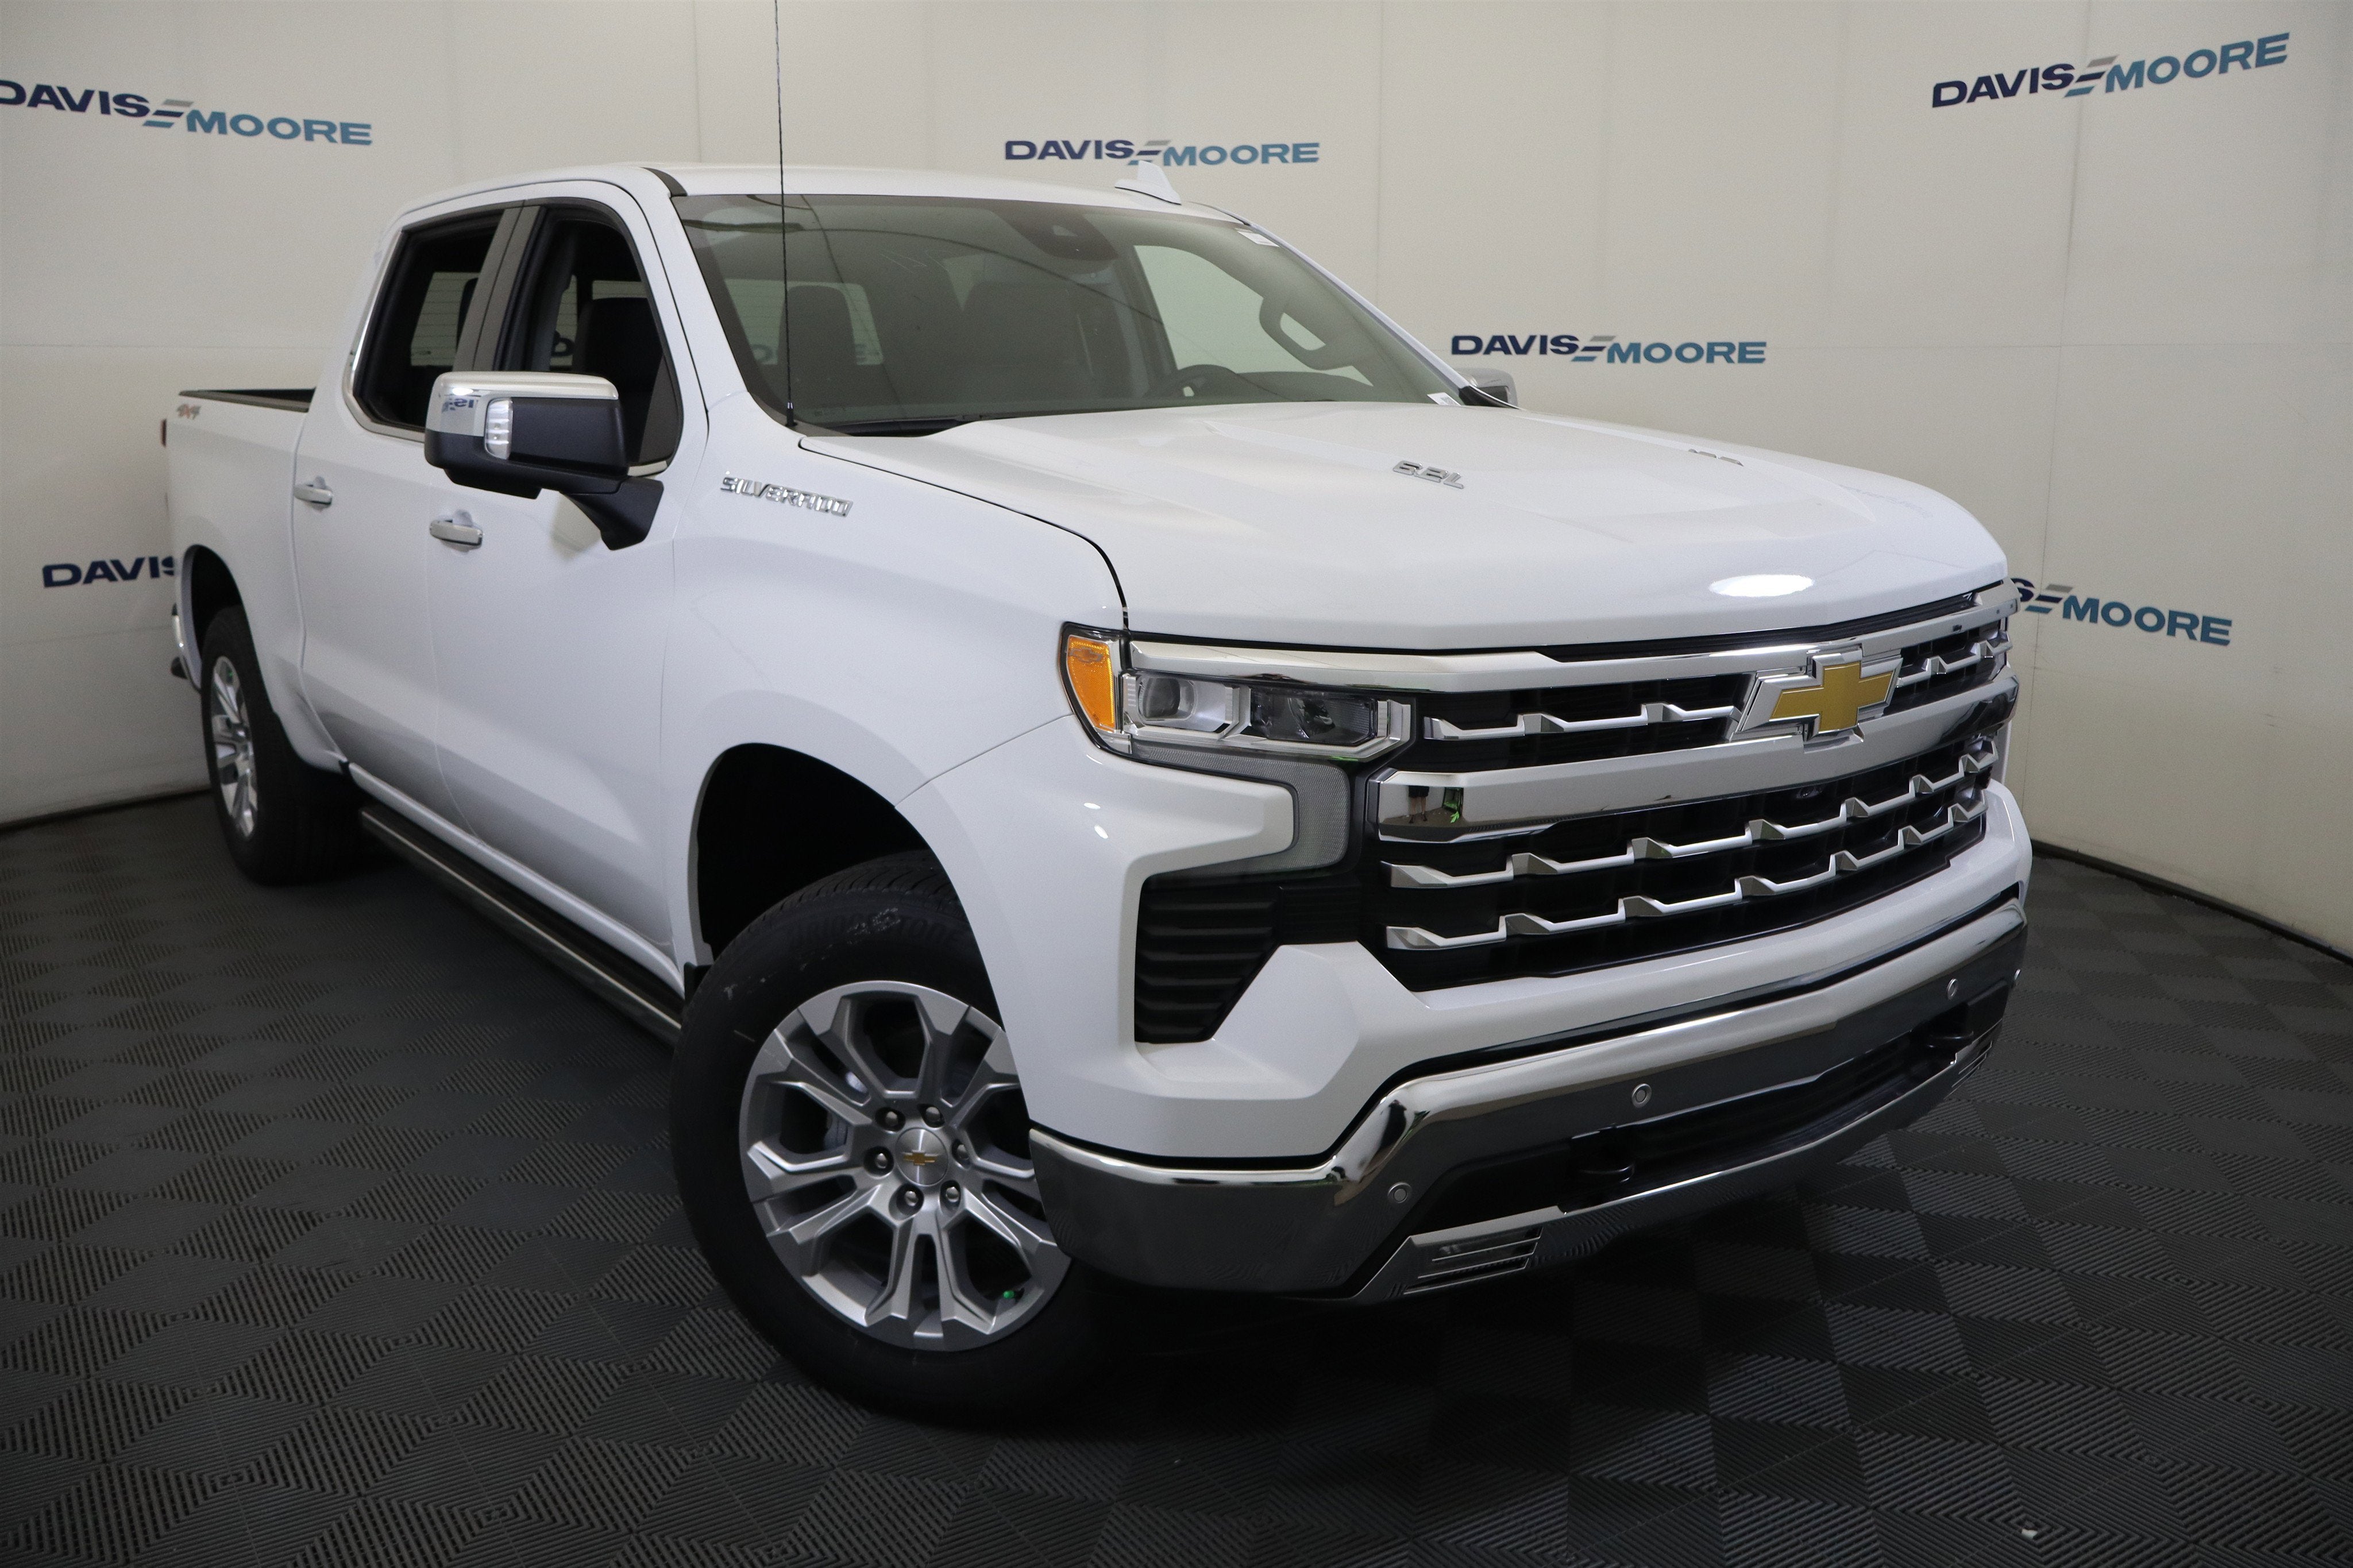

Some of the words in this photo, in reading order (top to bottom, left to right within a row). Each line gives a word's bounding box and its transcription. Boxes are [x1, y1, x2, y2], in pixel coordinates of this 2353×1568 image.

[1932, 63, 2075, 108] DAVIS
[2105, 32, 2290, 94] MOORE
[0, 79, 150, 118] DAVIS
[186, 110, 372, 146] MOORE
[1005, 140, 1135, 160] DAVIS
[1163, 142, 1320, 166] MOORE
[1451, 334, 1580, 356] DAVIS
[1607, 341, 1767, 364] MOORE
[720, 477, 854, 517] SILVERADO
[2062, 595, 2232, 647] MOORE
